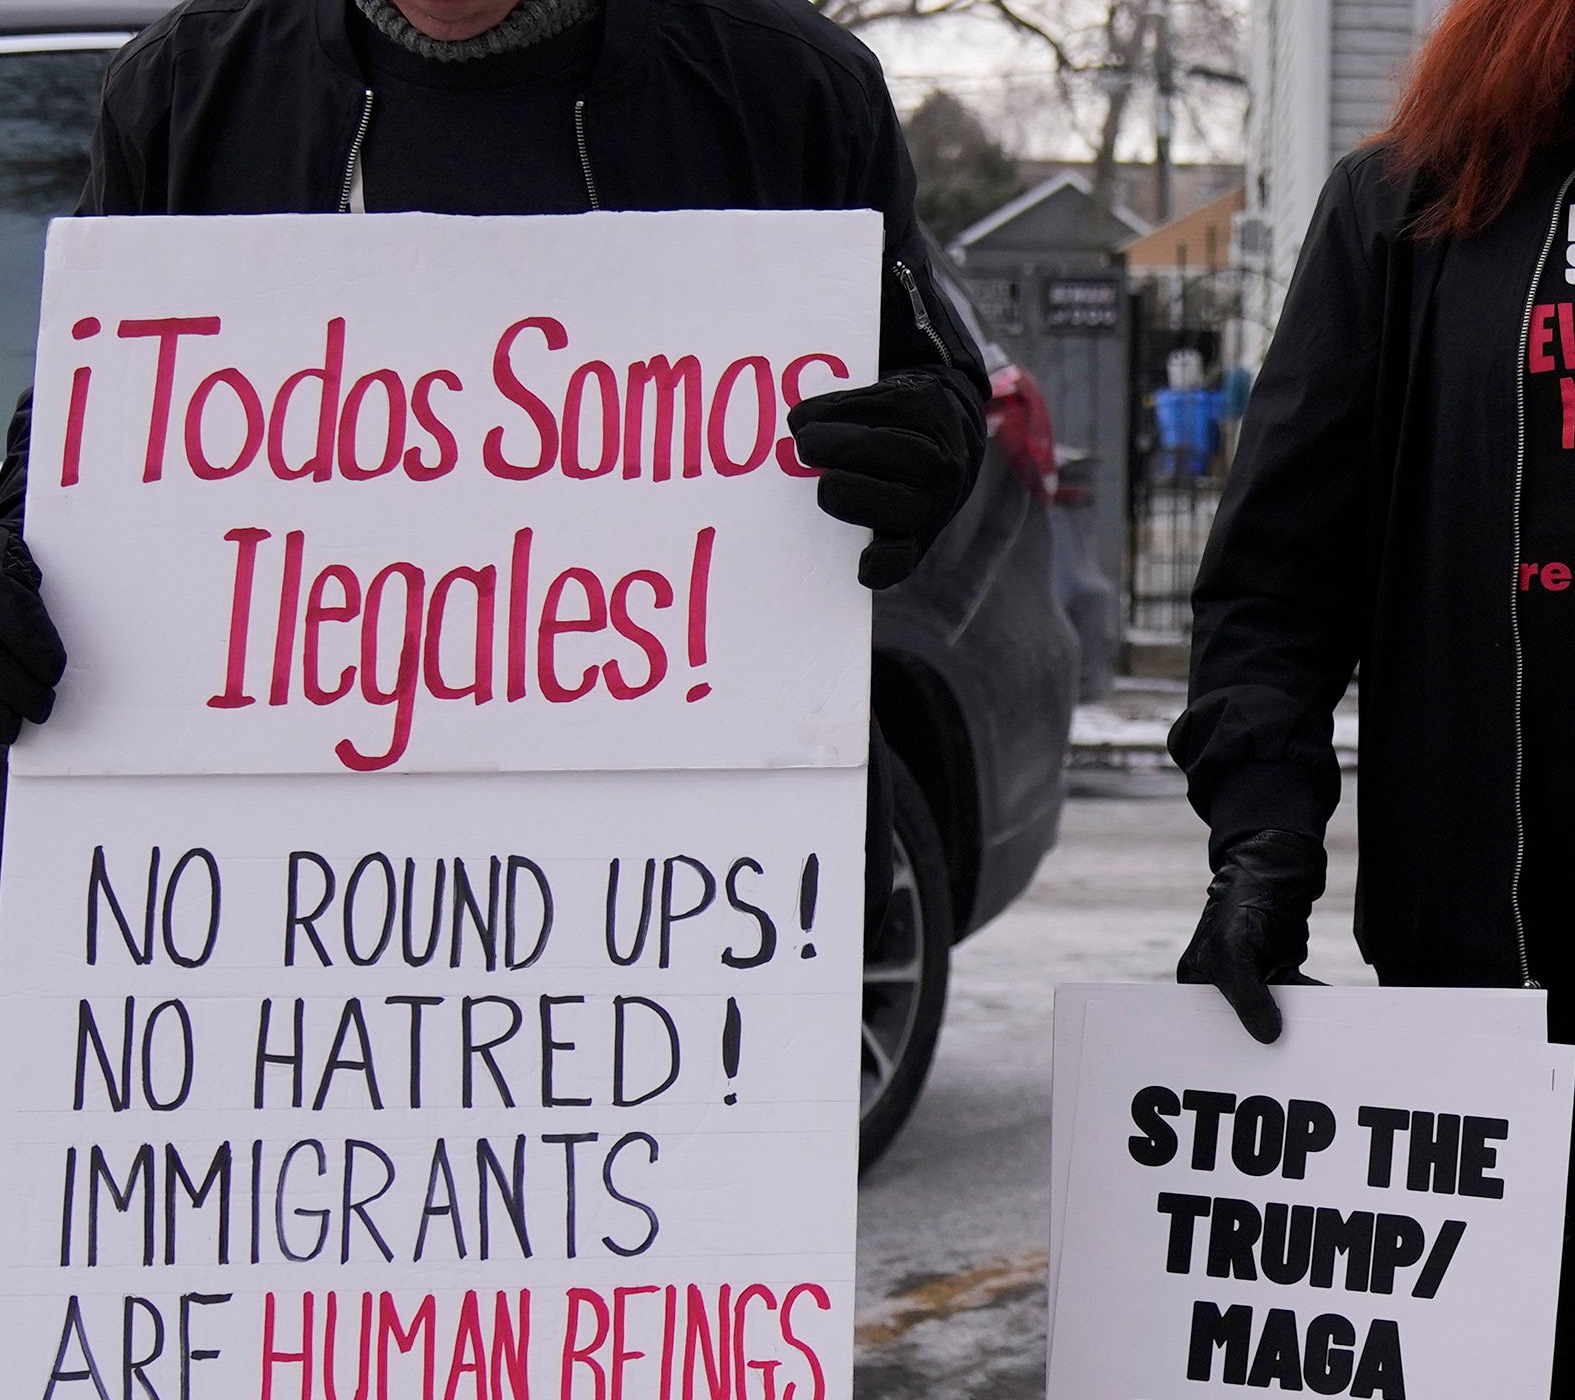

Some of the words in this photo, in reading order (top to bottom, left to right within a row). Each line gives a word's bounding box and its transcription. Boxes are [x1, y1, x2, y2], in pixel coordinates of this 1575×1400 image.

[483, 317, 849, 482] Somos
[207, 527, 715, 772] Ilegales!
[87, 846, 220, 968] NO
[285, 851, 553, 972] ROUND
[606, 853, 818, 969] UPS!
[73, 996, 193, 1112] NO
[60, 1132, 658, 1267] IMMIGRANTS
[1128, 1086, 1336, 1180] STOP
[1358, 1106, 1509, 1199] THE
[1159, 1191, 1466, 1298] TRUMP/
